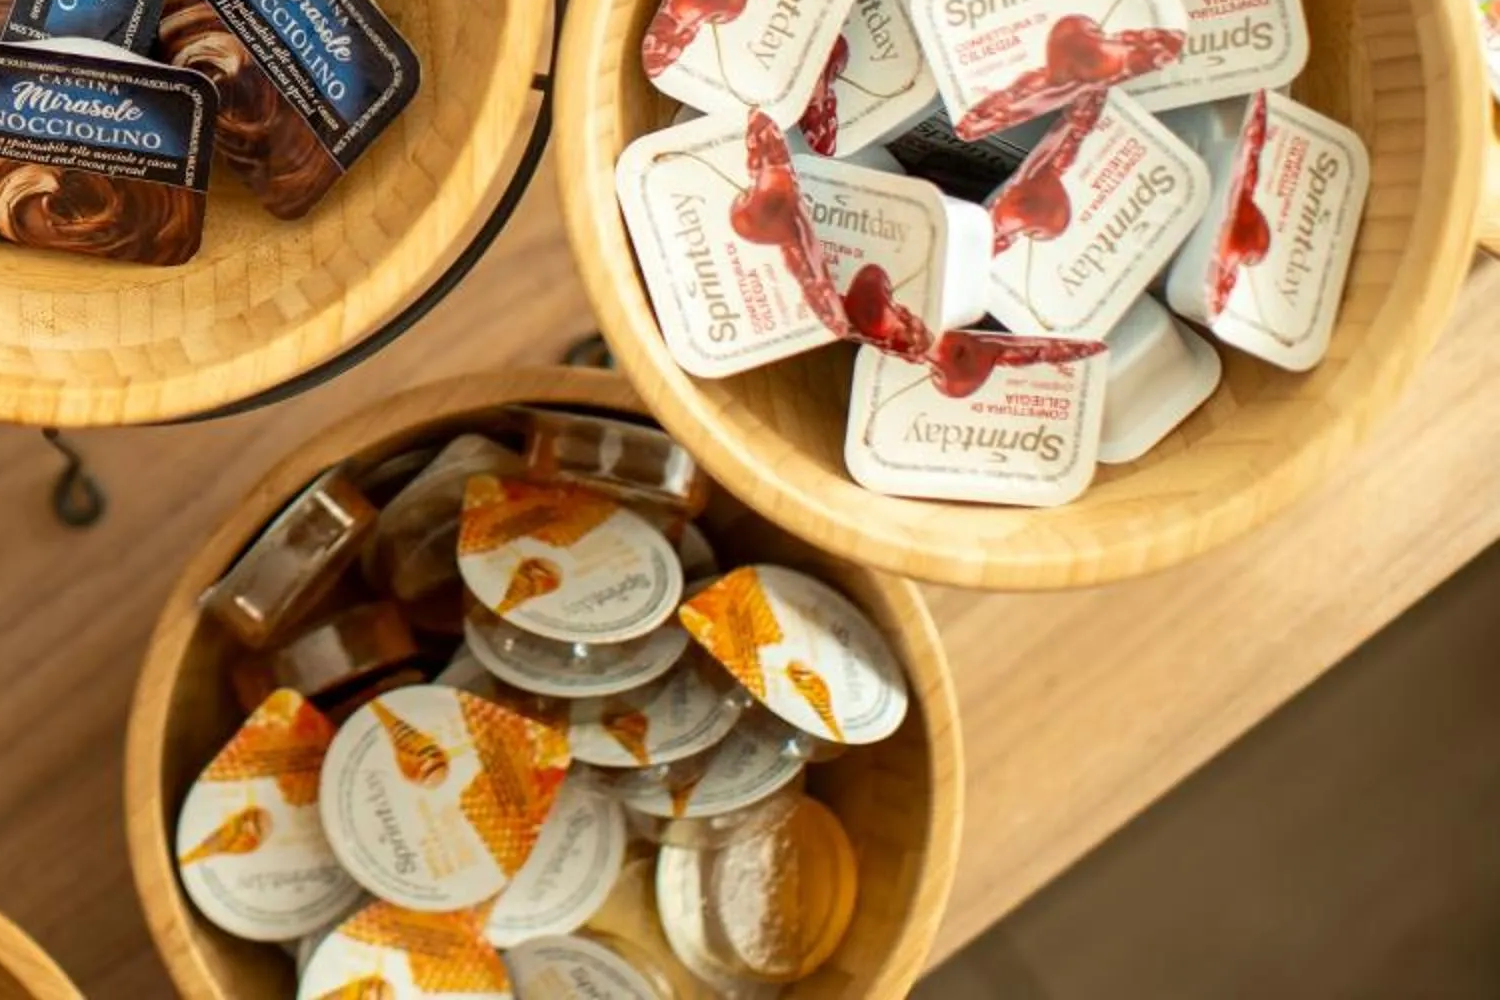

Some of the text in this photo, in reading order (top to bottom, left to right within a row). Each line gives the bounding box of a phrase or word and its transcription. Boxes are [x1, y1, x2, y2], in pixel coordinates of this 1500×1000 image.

[12, 81, 144, 122] Mirasole
[39, 73, 119, 96] CASCINA
[671, 191, 741, 344] Sprintday
[1056, 164, 1176, 295] Sprintday
[1275, 151, 1340, 310] Sprintday
[912, 413, 1063, 461] Sprintday
